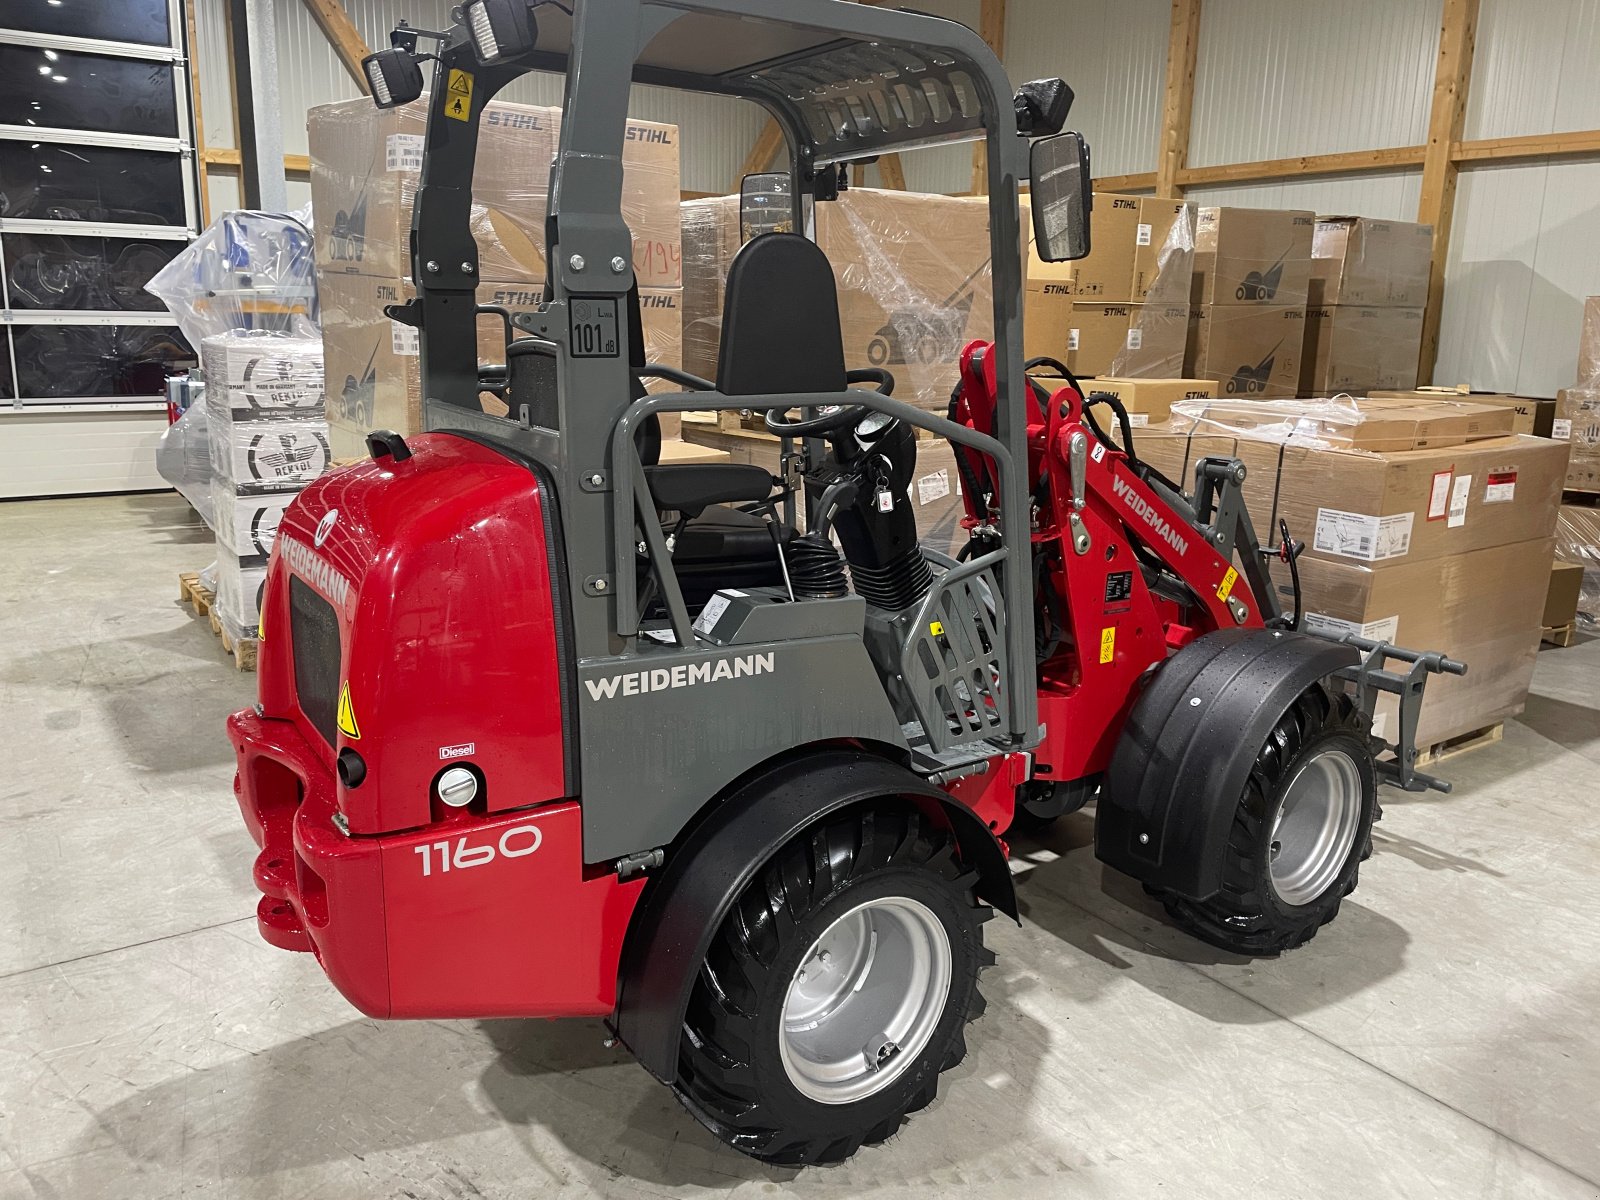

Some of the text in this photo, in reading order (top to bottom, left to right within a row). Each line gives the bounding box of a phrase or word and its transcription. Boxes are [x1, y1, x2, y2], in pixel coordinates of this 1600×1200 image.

[488, 111, 543, 131] STIHL
[626, 127, 671, 144] STIHL
[1113, 200, 1137, 209] STIHL
[376, 286, 398, 300] STIHL
[1043, 285, 1070, 295] STIHL
[1104, 308, 1127, 316] STIHL
[1284, 311, 1304, 319] STIHL
[574, 323, 602, 353] 101
[605, 340, 615, 353] dB
[1185, 391, 1210, 399] STIHL
[275, 460, 312, 477] REKTOL
[1113, 474, 1188, 557] WEIDEMANN
[280, 531, 351, 605] WEIDEMANN
[585, 652, 775, 702] WEIDEMANN
[441, 744, 473, 758] Diesel
[414, 825, 543, 876] 1160
